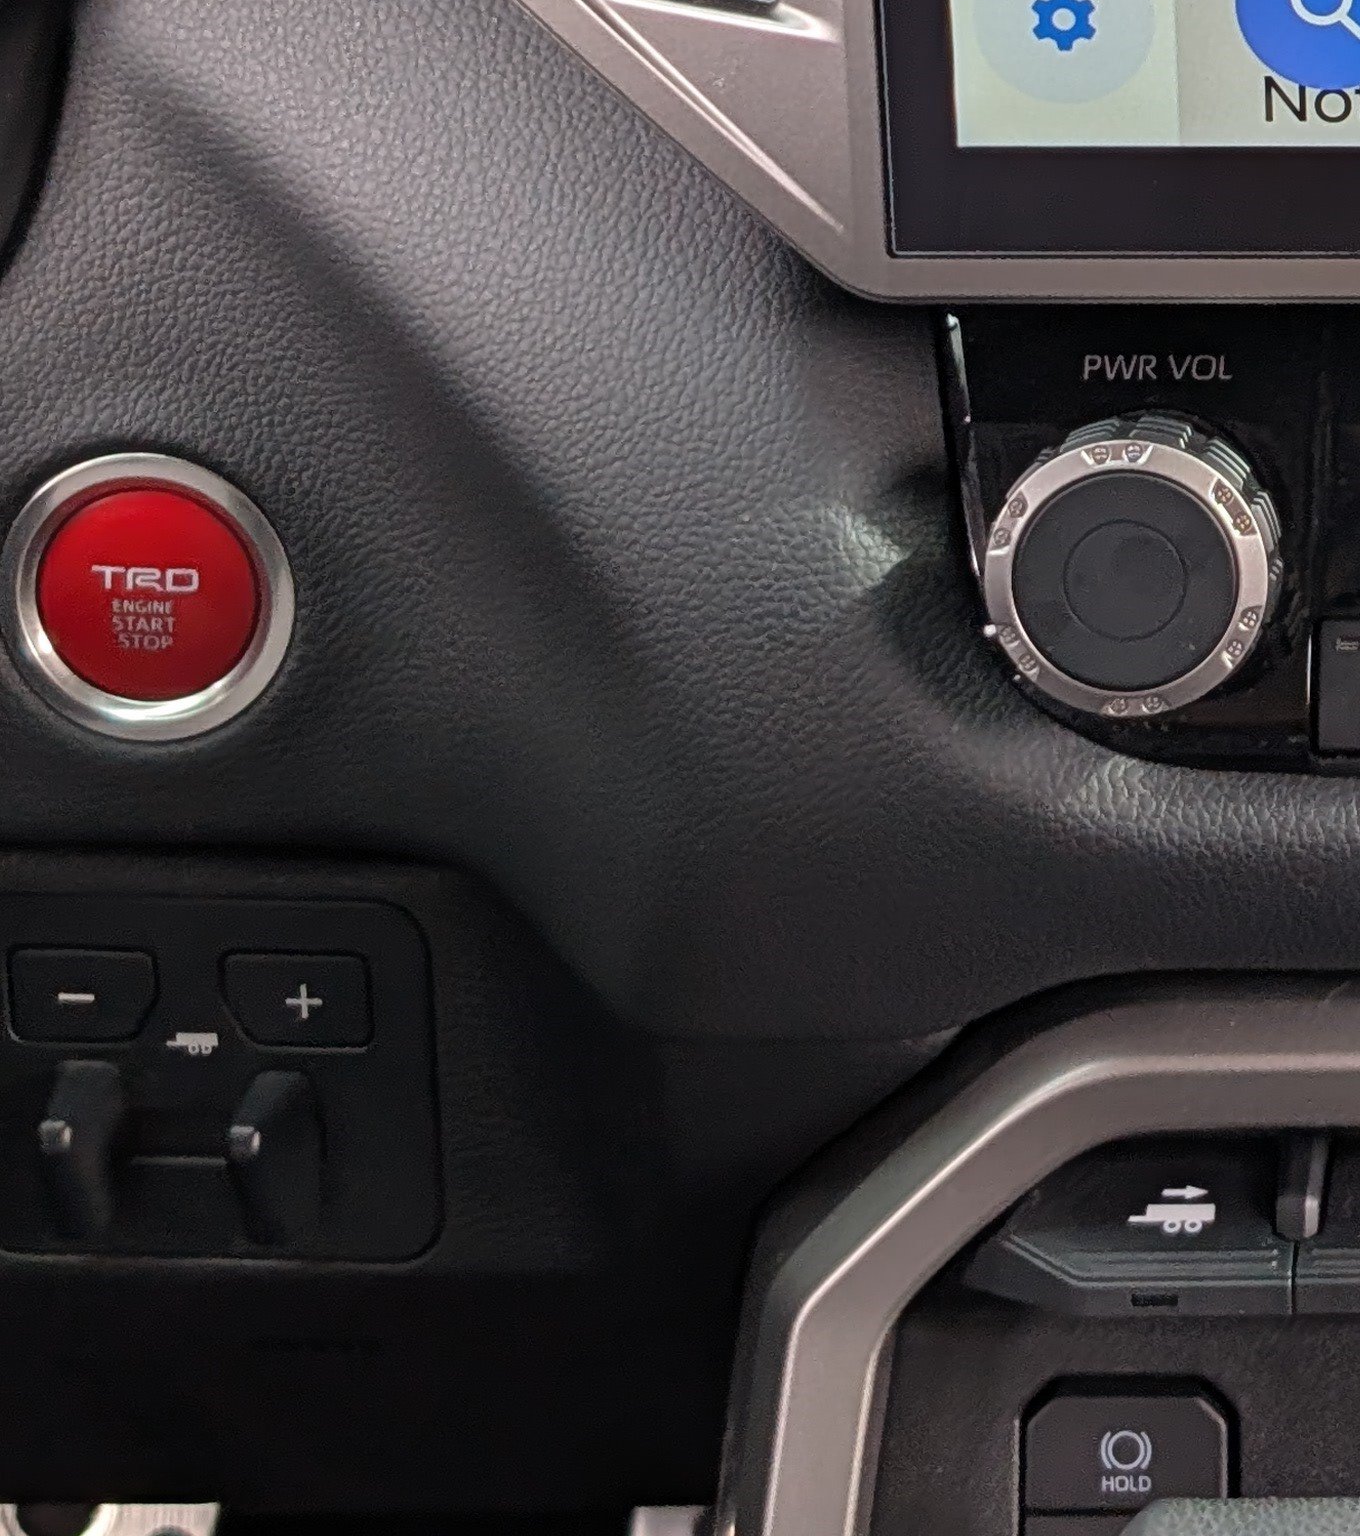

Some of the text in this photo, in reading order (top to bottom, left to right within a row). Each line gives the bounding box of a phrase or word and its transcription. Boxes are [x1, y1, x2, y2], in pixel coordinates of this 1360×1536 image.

[1083, 355, 1232, 380] PWR VOL
[92, 565, 199, 592] TRD
[112, 599, 173, 613] ENGINE
[113, 616, 174, 632] START
[119, 634, 173, 650] STOP
[1102, 1475, 1151, 1492] HOLD
